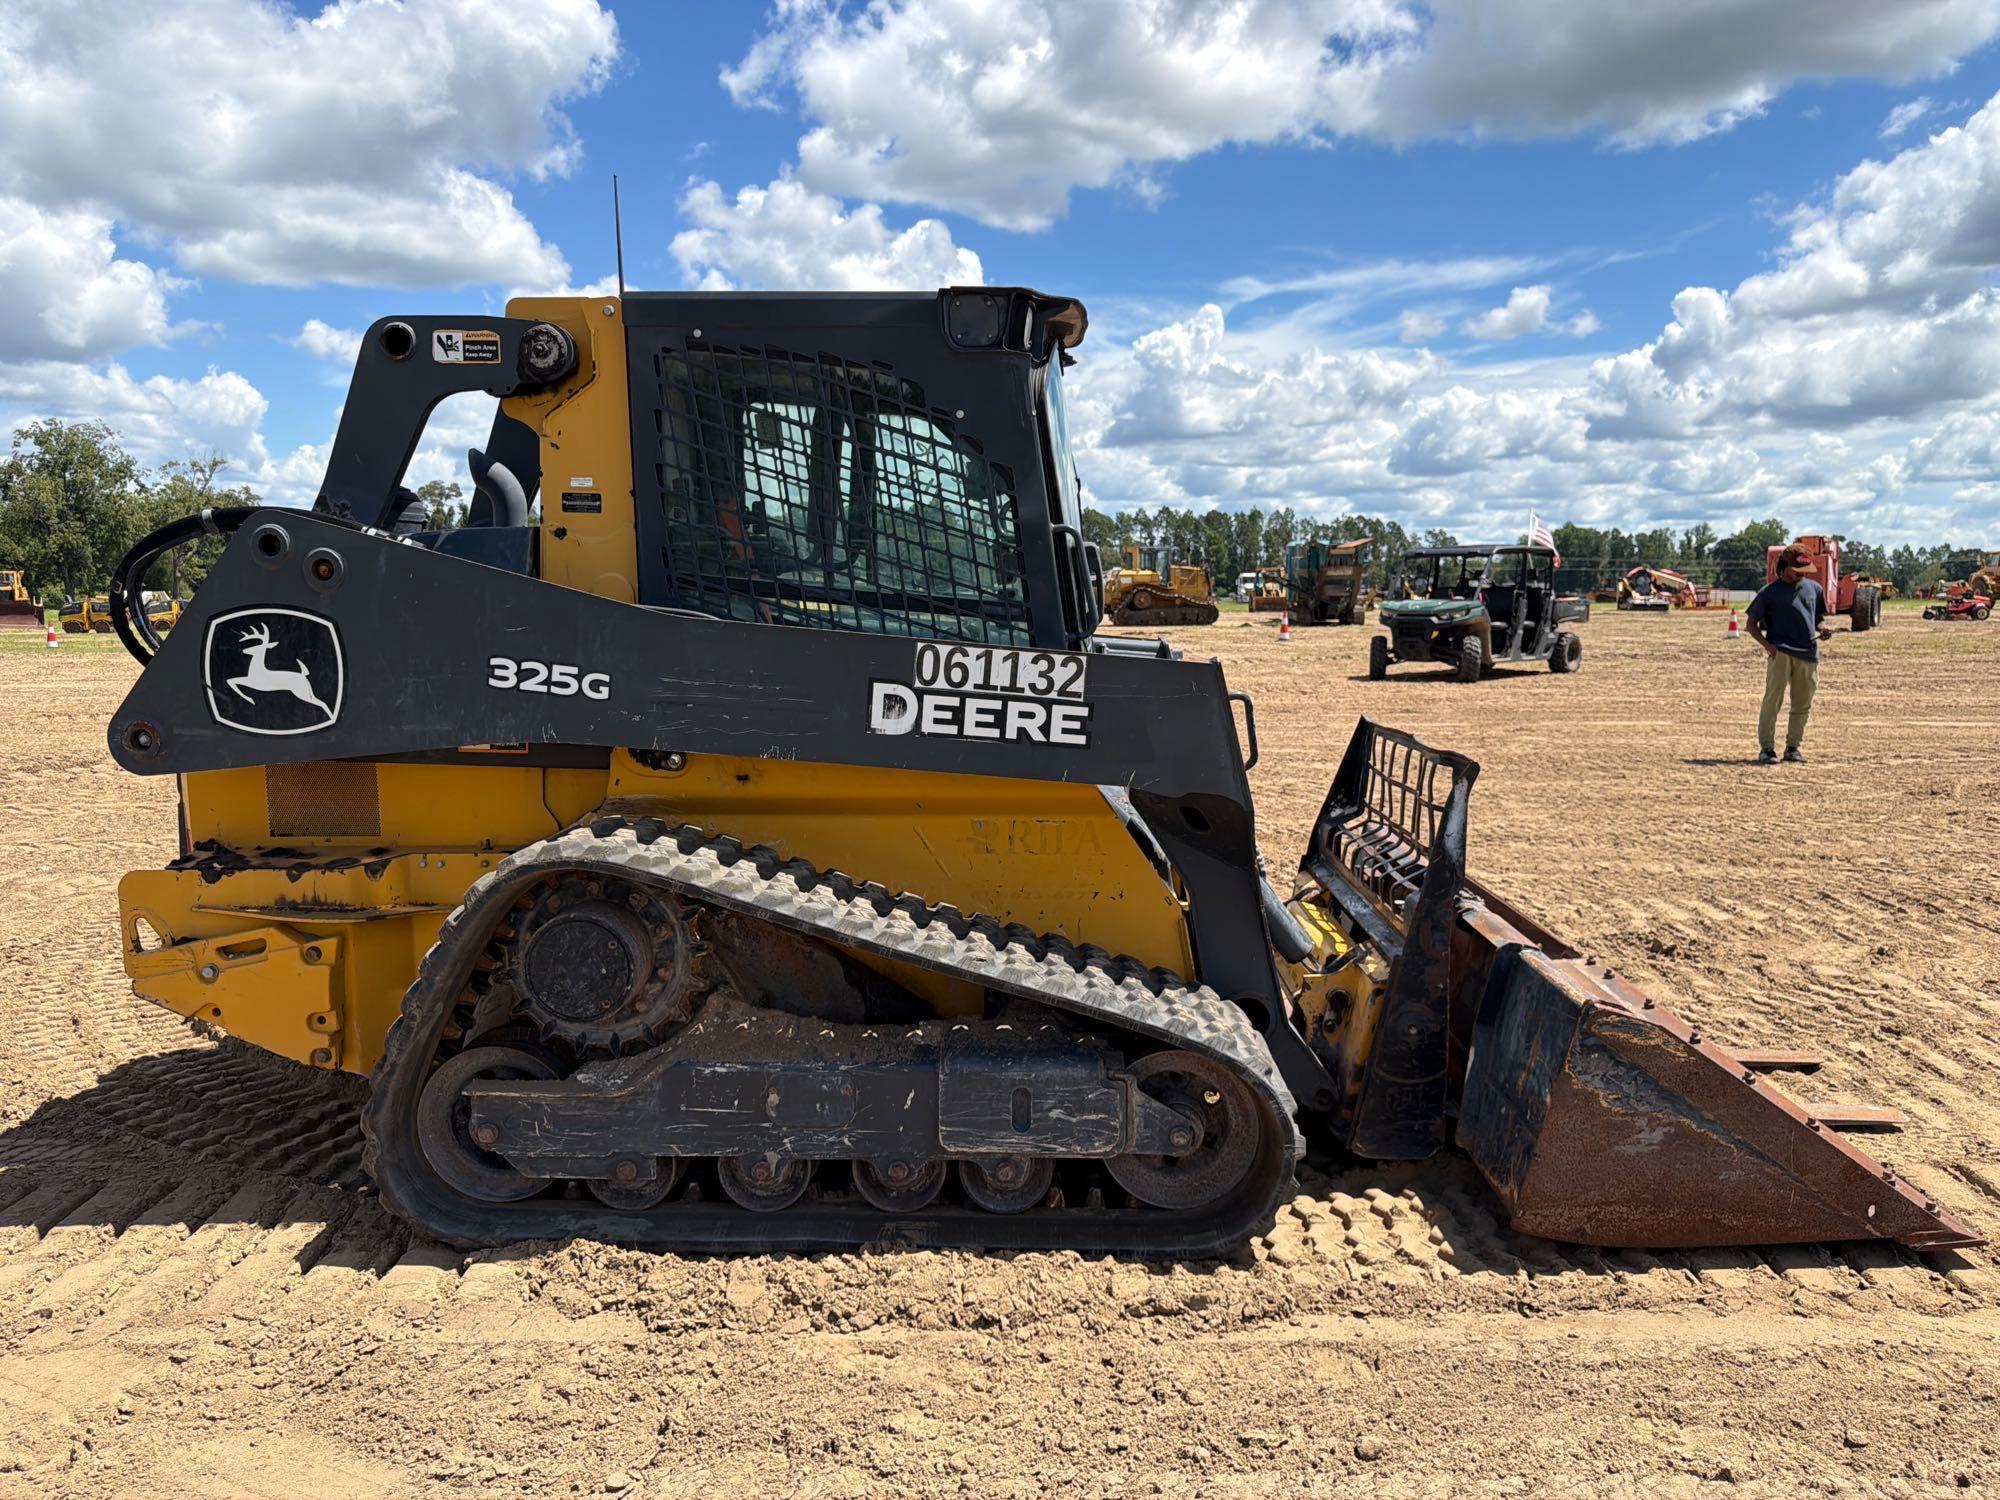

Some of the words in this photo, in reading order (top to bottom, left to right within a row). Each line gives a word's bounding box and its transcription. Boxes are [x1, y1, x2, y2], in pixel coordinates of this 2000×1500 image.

[488, 657, 611, 700] 325G
[915, 643, 1085, 699] 061132
[870, 681, 1090, 746] DEERE
